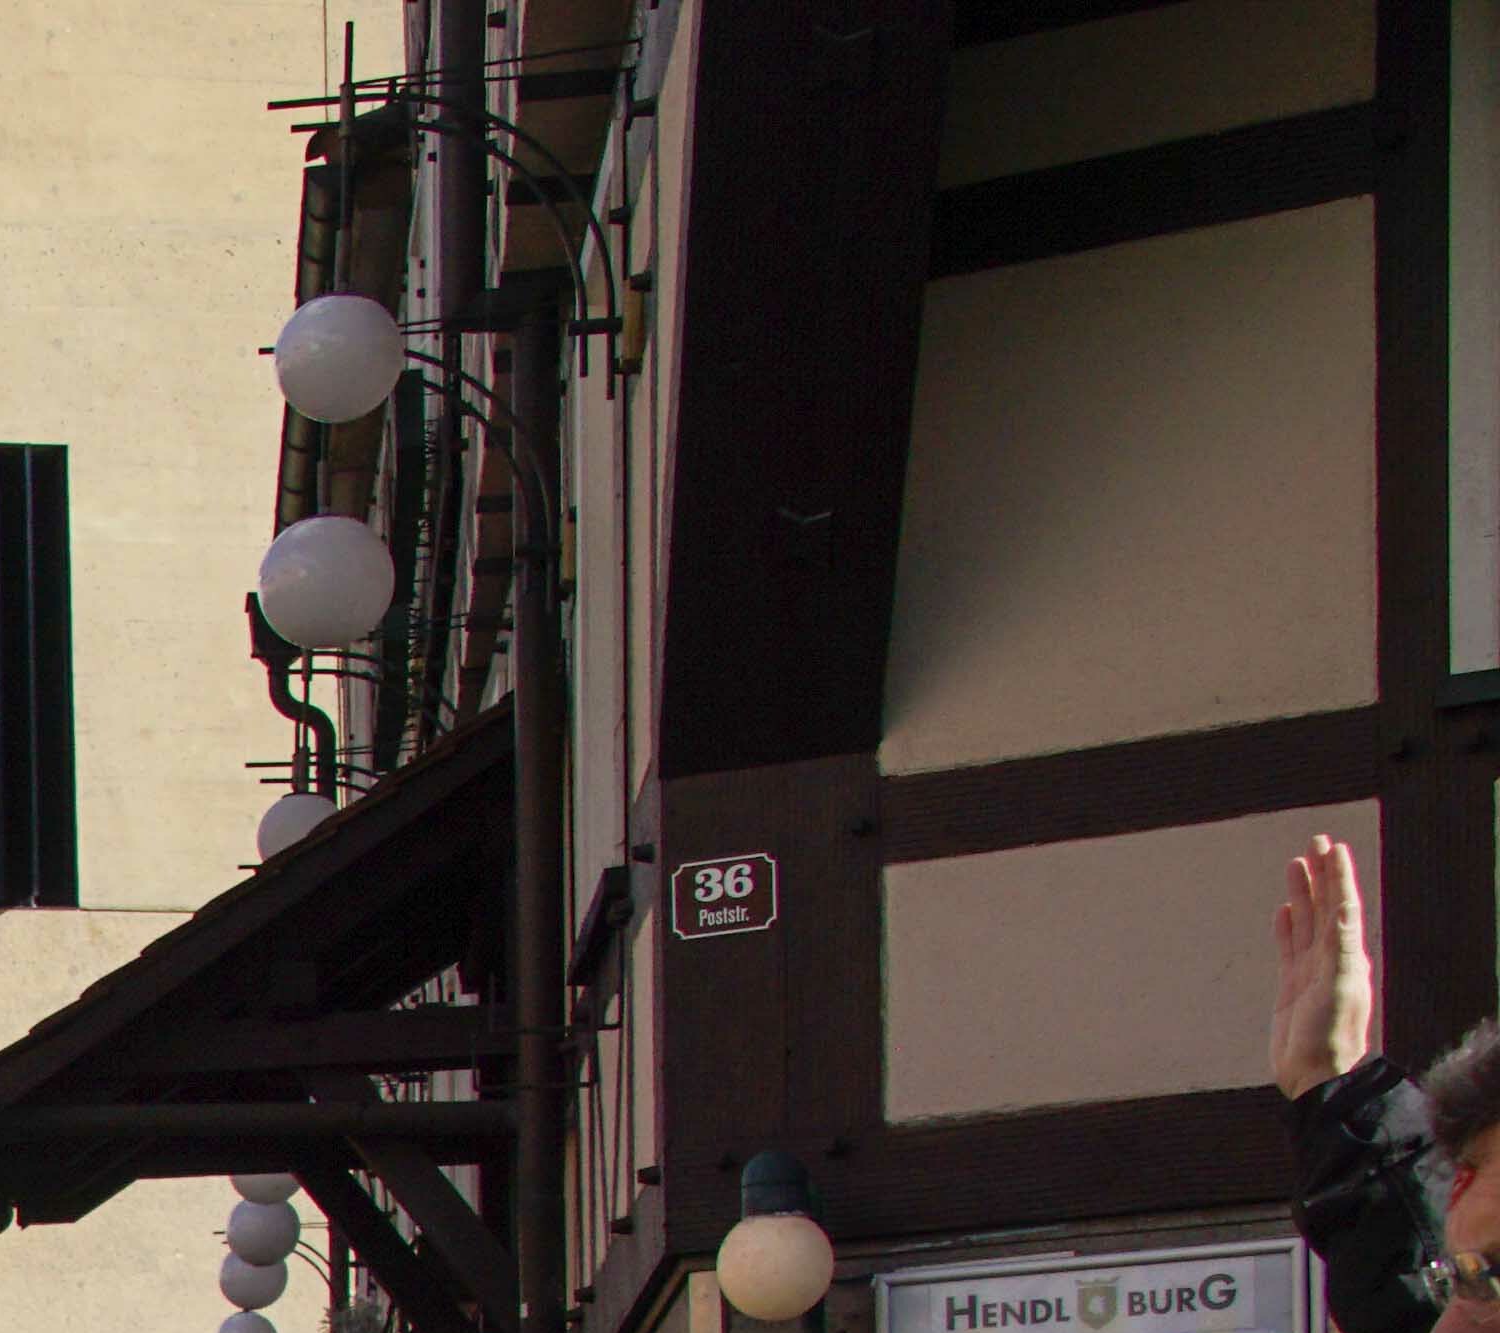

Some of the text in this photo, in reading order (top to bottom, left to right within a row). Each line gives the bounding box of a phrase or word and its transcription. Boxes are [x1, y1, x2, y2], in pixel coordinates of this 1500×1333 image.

[694, 863, 754, 902] 36
[699, 905, 750, 927] Poststr.
[945, 1294, 1071, 1331] HENDL
